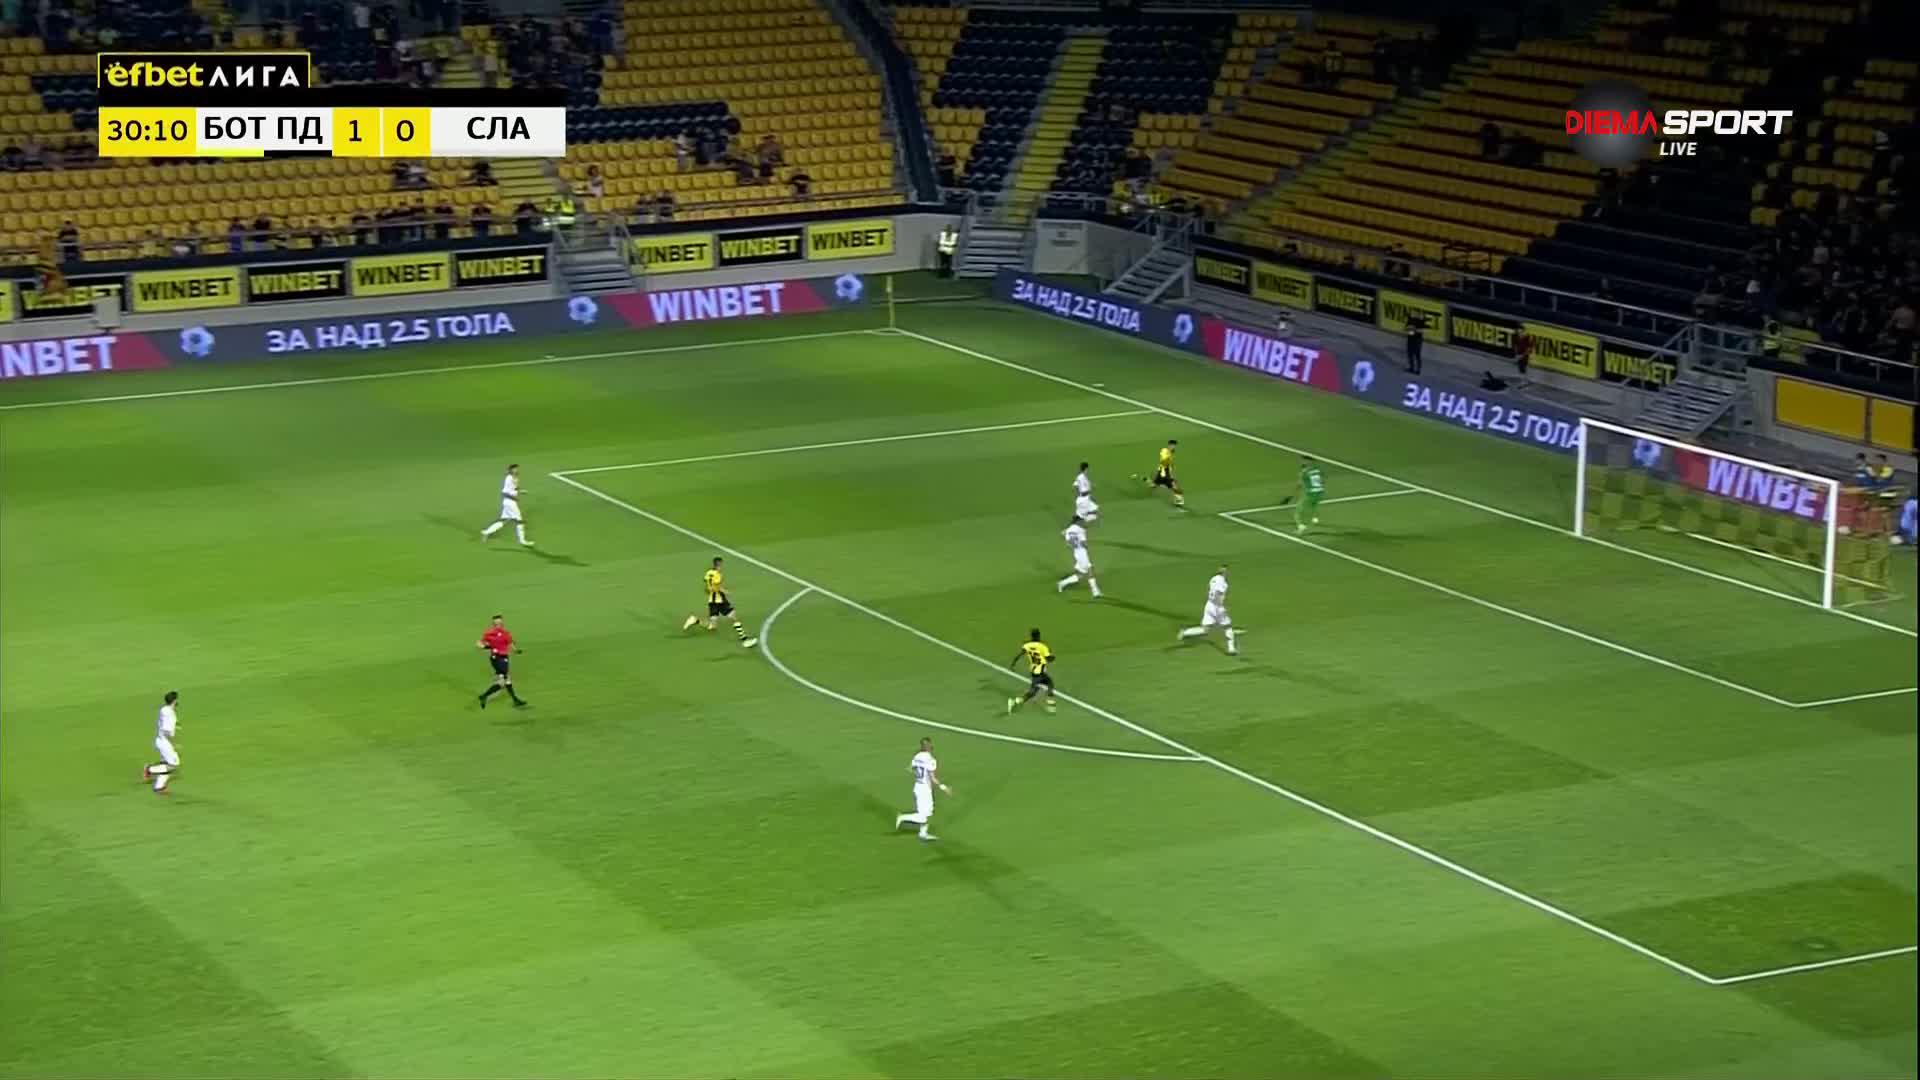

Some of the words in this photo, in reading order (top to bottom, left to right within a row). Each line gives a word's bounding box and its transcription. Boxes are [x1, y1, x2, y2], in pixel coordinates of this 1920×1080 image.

[720, 234, 800, 258] WINBET
[811, 228, 889, 250] WINBET
[250, 270, 342, 294] WINBET
[356, 262, 445, 287] WINBET
[458, 255, 545, 279] WINBET
[139, 277, 233, 300] WINBET
[649, 282, 785, 323] WINBET
[1012, 278, 1036, 303] ЗА
[1036, 285, 1071, 316] НАД
[1099, 301, 1141, 332] ГОЛА
[266, 330, 310, 352] ЗА
[316, 323, 386, 348] НАД
[437, 312, 515, 338] ГОЛА
[1223, 327, 1320, 383] WINBET
[1403, 383, 1431, 411] ЗА
[1436, 391, 1484, 429] НАД
[1707, 457, 1830, 522] WINBE
